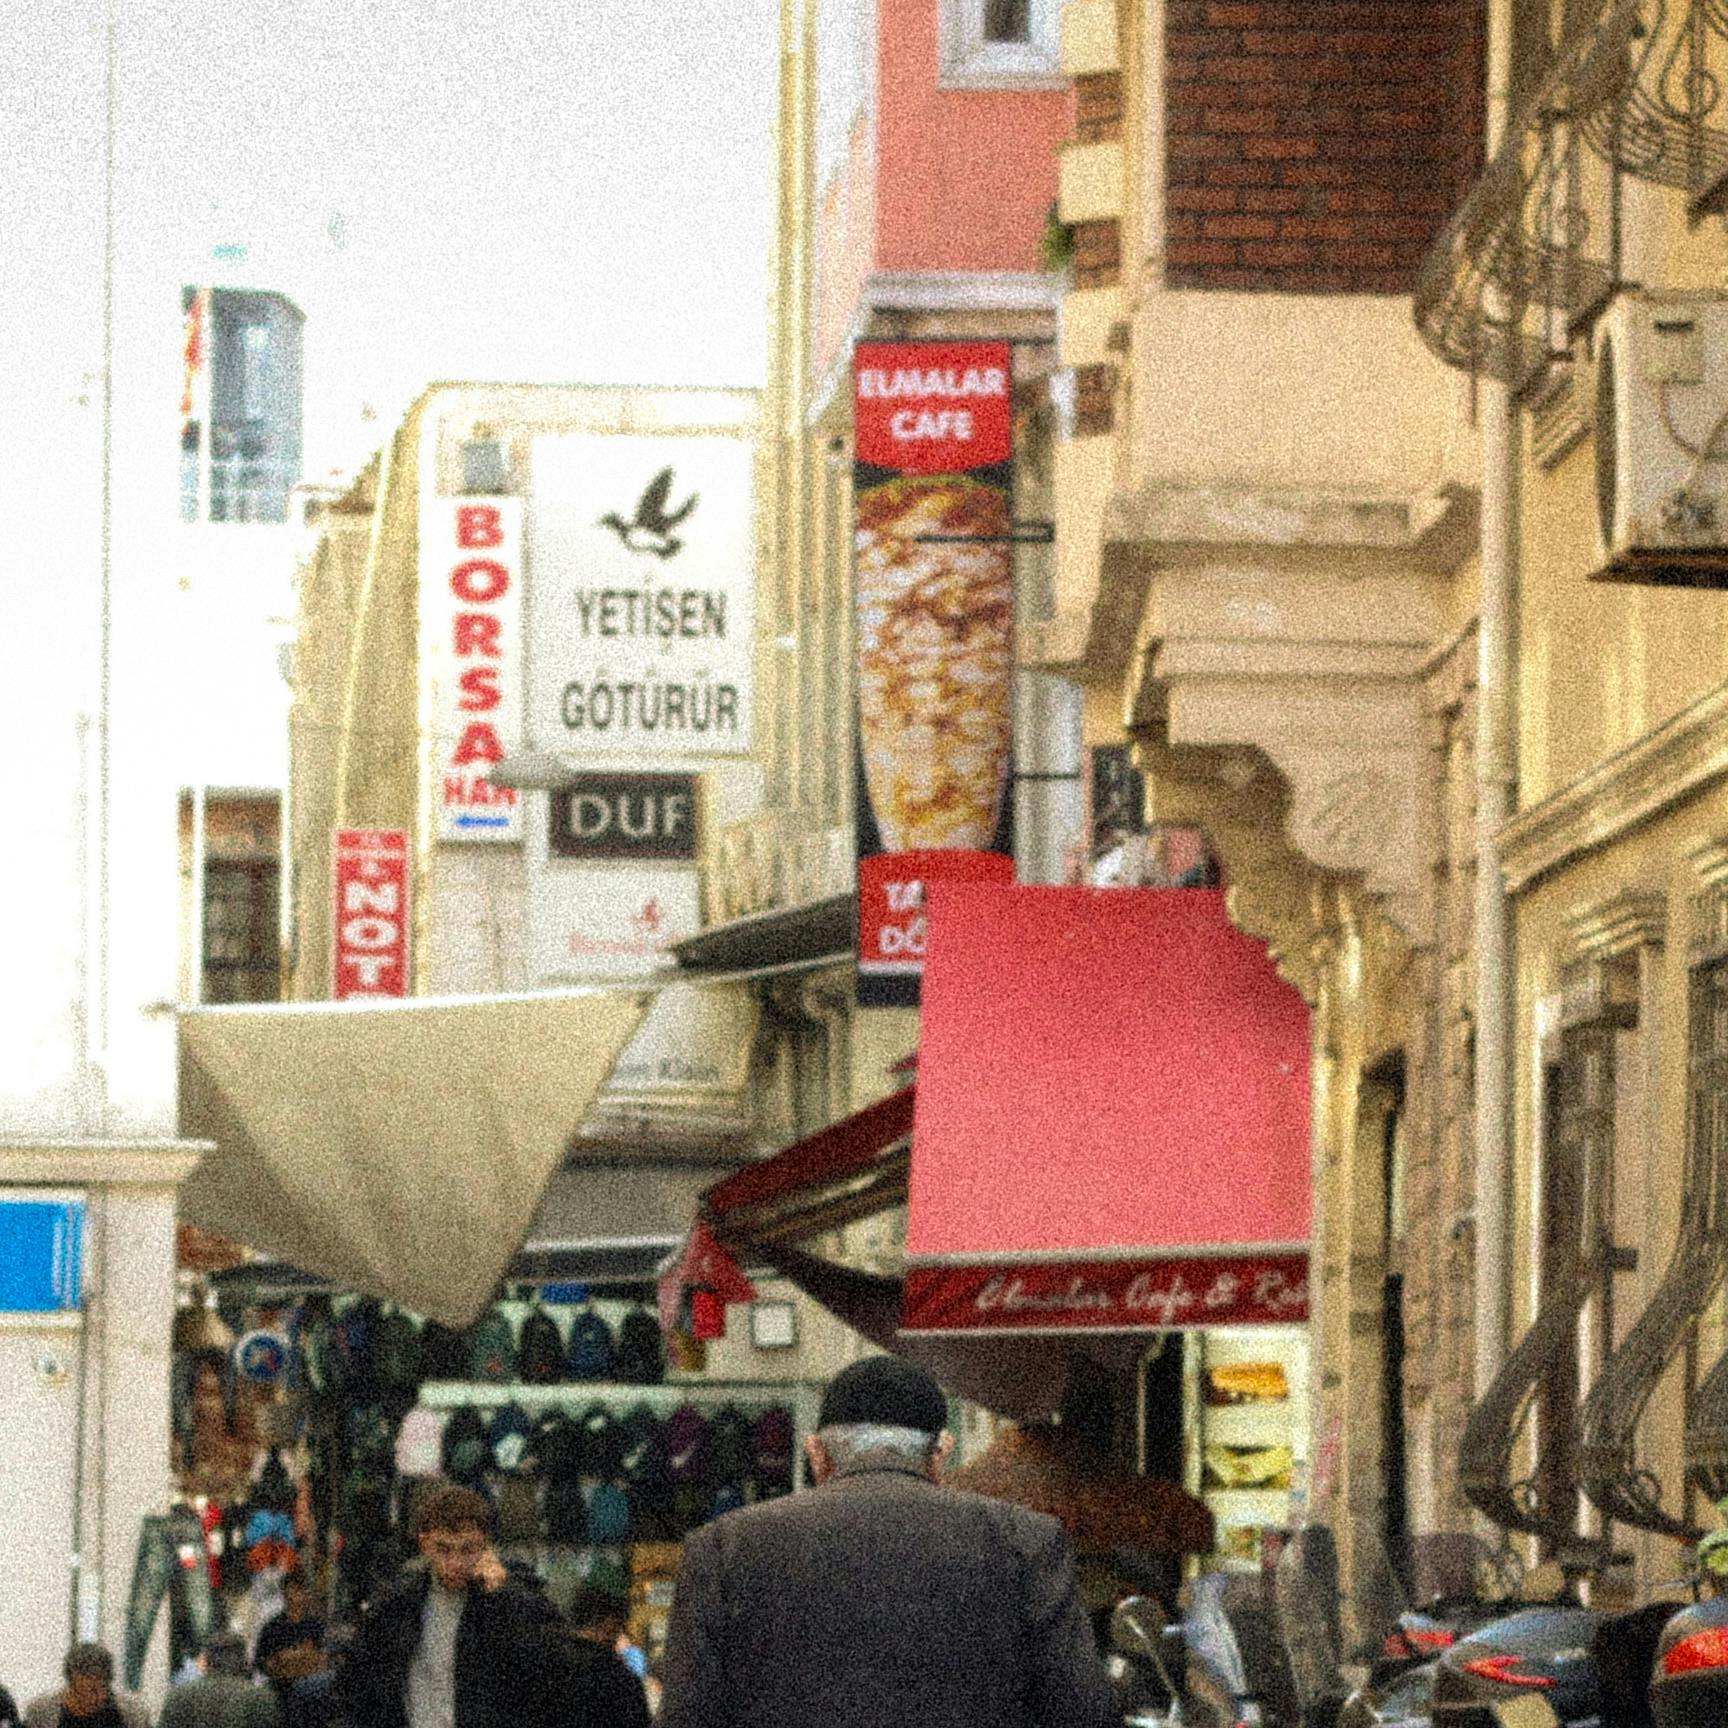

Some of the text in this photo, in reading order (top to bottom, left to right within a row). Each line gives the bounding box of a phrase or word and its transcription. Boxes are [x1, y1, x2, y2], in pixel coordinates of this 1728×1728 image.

[858, 367, 1006, 397] ELMALAR
[890, 410, 972, 440] CAFE
[448, 504, 510, 767] BORSA
[559, 668, 739, 734] GÖTÜRÜR
[342, 880, 399, 1000] NOT
